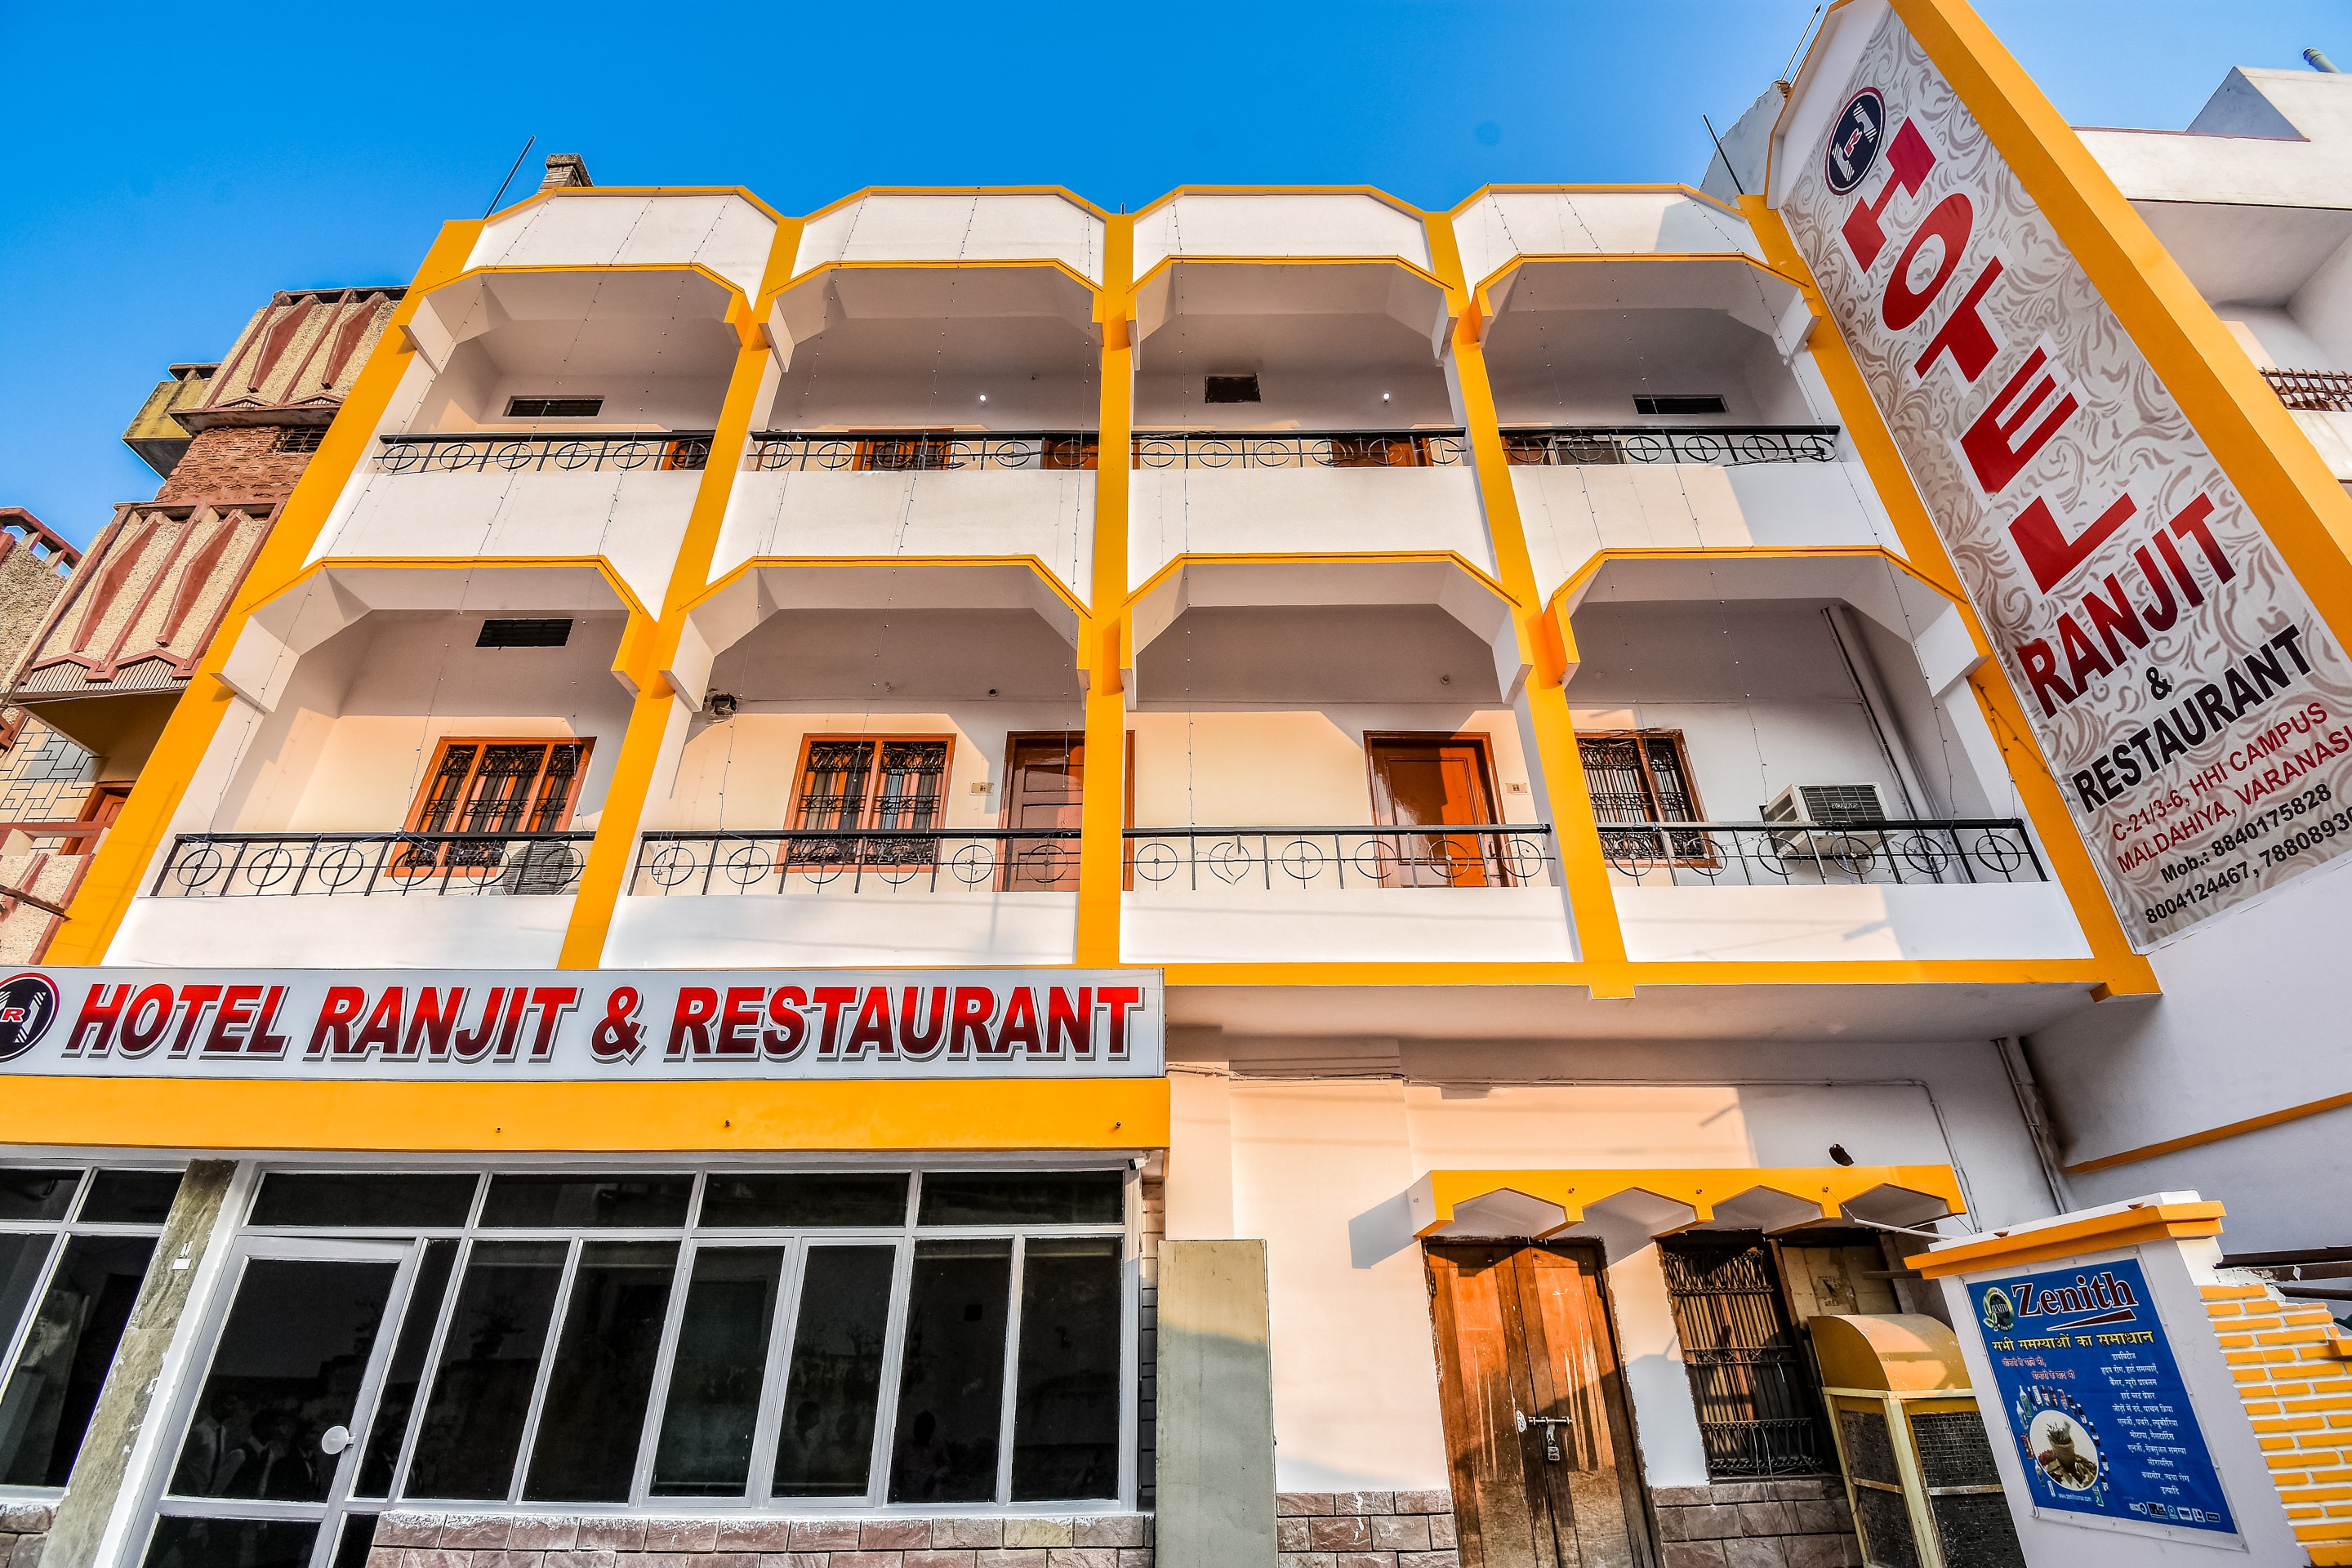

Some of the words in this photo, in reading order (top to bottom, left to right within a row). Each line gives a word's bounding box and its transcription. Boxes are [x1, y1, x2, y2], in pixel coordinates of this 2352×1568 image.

[1842, 116, 2137, 595] HOTEL
[2016, 492, 2236, 719] RANJIT
[2071, 625, 2312, 813] RESTAURANT
[2145, 666, 2172, 700] &
[2112, 790, 2190, 840] C-21/3-6,
[2189, 762, 2228, 796] HHI
[2230, 702, 2328, 772] CAMPUS
[2116, 800, 2237, 873] MALDAHIYA,
[2211, 783, 2332, 857] 8840175828
[2145, 862, 2260, 924] 8004124467,
[61, 983, 291, 1060] HOTEL
[303, 986, 583, 1062] RANJIT
[590, 986, 647, 1064] &
[663, 986, 1145, 1062] RESTAURANT
[2011, 1272, 2139, 1317] Zenith
[1992, 1335, 2015, 1352] सभी
[2017, 1333, 2072, 1350] समस्याओं
[2074, 1335, 2093, 1348] का
[2096, 1330, 2154, 1347] समाधान
